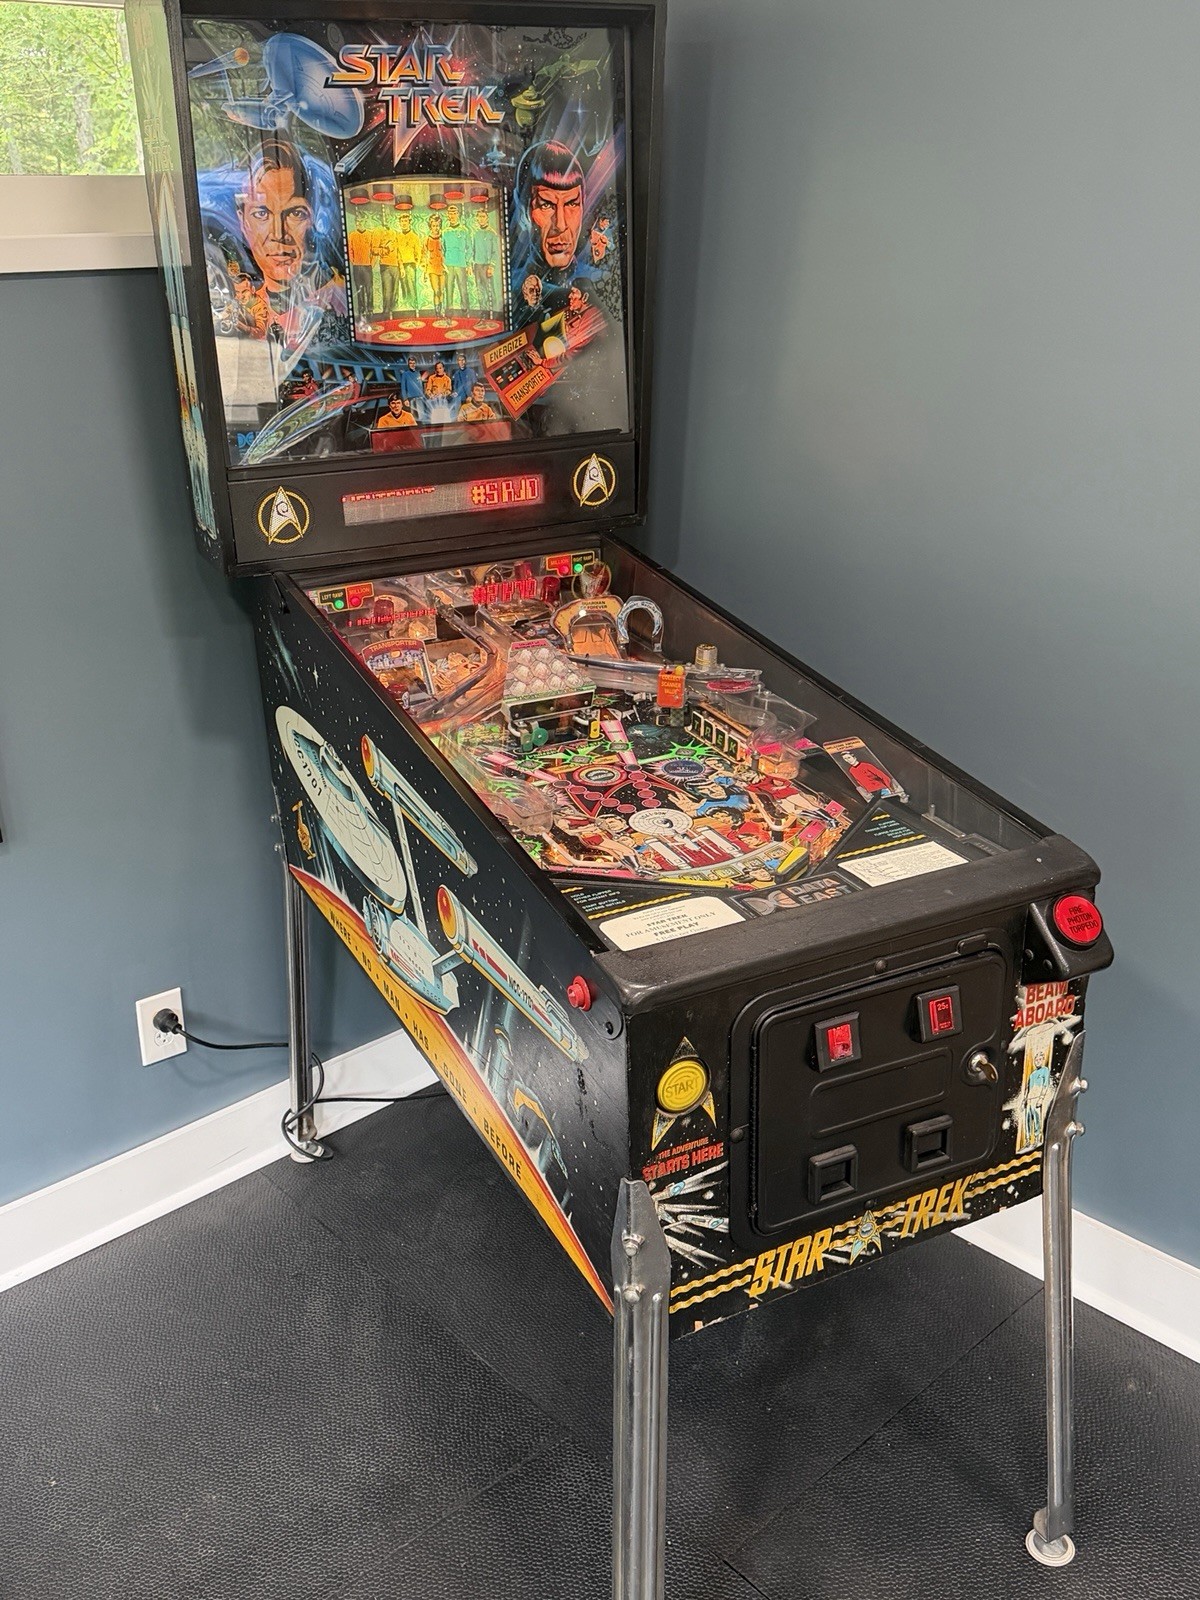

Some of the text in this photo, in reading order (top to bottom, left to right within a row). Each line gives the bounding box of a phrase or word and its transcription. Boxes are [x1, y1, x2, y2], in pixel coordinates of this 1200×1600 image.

[324, 44, 464, 88] STAR
[378, 85, 506, 127] TREK
[489, 336, 523, 363] ENERGIZE
[510, 370, 546, 404] TRANSPORTER
[369, 640, 417, 652] TRANSPORTER
[787, 877, 840, 896] DATA
[799, 885, 852, 905] EAST
[647, 918, 666, 926] STAR
[1067, 912, 1093, 925] PHOTON
[1069, 905, 1083, 915] FIRE
[626, 928, 644, 938] FOR
[644, 917, 693, 934] AMUSEMENT
[694, 911, 716, 920] ONLY
[654, 928, 677, 936] FREE
[676, 922, 699, 931] PLAY
[1069, 920, 1099, 934] TORPEDO
[1025, 981, 1069, 1005] BEAM
[1014, 994, 1075, 1032] ABOARD
[330, 908, 522, 1181] WHERE NO MAN HAS GONE BEFORE
[658, 1136, 709, 1160] THE ADVENTURE
[641, 1142, 724, 1182] STARTS HERE
[749, 1174, 974, 1297] STAR TREK
